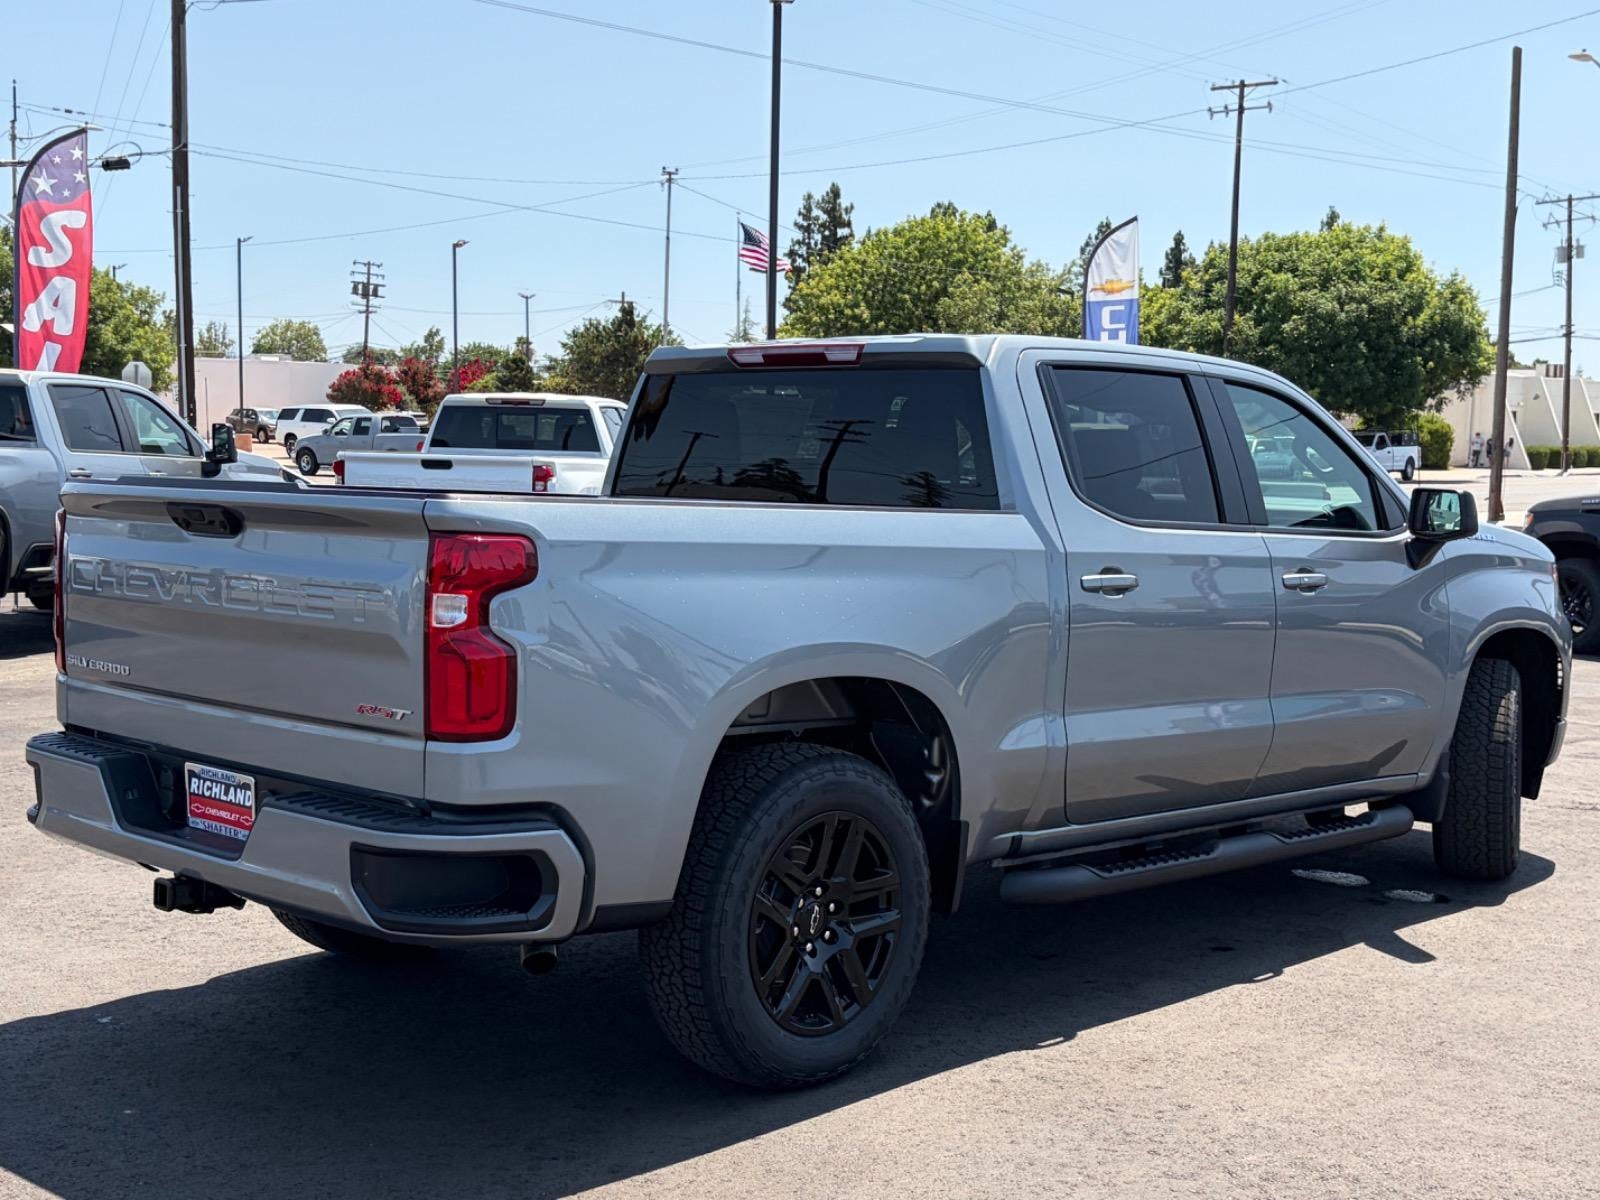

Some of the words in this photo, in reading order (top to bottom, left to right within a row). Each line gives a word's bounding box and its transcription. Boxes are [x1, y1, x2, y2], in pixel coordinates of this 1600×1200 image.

[71, 558, 386, 622] CHEVROLET
[67, 655, 130, 676] SILVERADO
[356, 703, 413, 720] RST
[200, 768, 237, 783] RICHLAND
[190, 777, 253, 807] RICHLAND
[205, 807, 240, 821] CHEVROLET
[202, 820, 240, 837] SHAFTER
